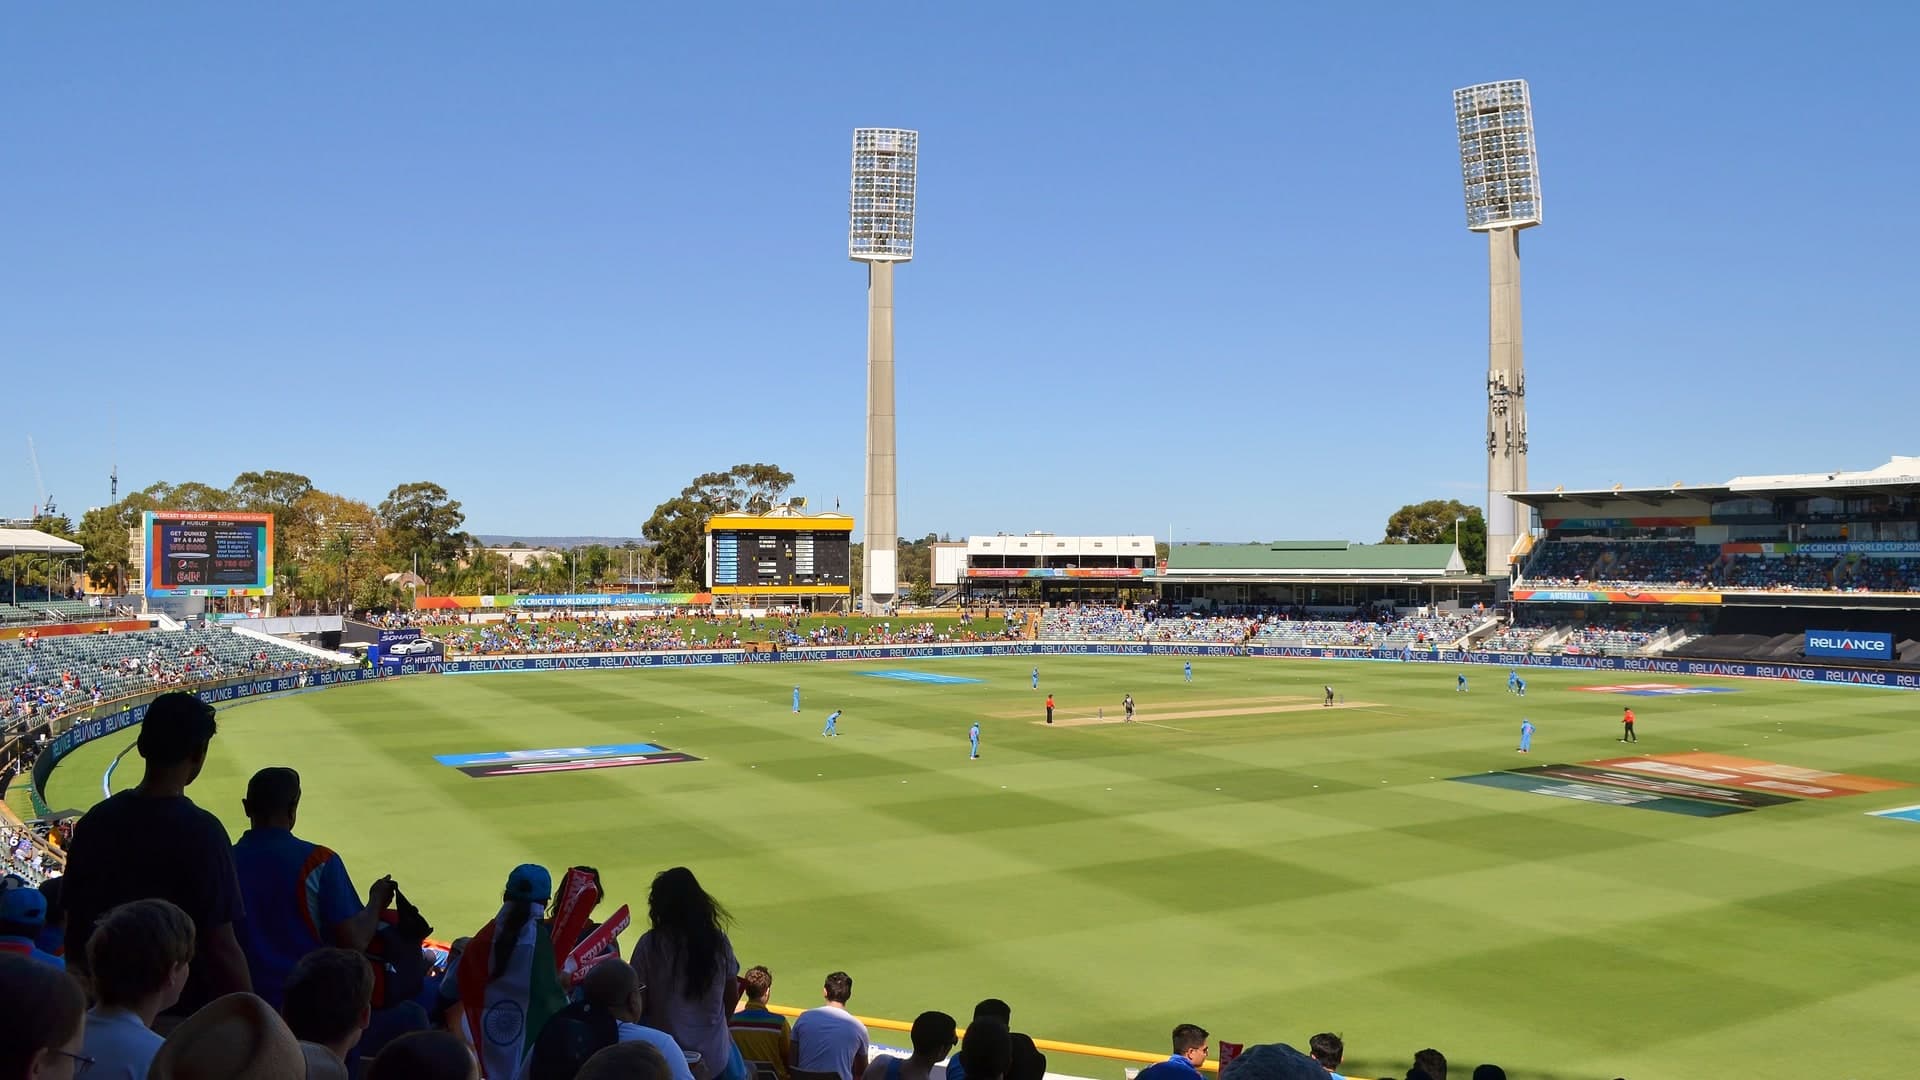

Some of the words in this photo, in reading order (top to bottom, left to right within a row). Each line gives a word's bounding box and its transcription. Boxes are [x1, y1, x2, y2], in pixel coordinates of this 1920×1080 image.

[1796, 543, 1810, 552] ICC
[1811, 543, 1847, 552] CRICKET
[1849, 543, 1884, 552] WORLD
[1884, 543, 1904, 551] CUP
[380, 634, 419, 642] SONATA
[1810, 638, 1885, 650] RELIANCE
[836, 650, 881, 659] RELIANCE
[890, 648, 934, 656] RELIANCE
[942, 646, 984, 656] RELIANCE
[992, 646, 1032, 654] RELIANCE
[1152, 646, 1199, 654] RELIANCE
[1264, 647, 1312, 656] RELIANCE
[414, 656, 442, 664] HYUNDAI
[600, 656, 652, 666] RELIANCE
[662, 654, 712, 664] RELIANCE
[722, 652, 770, 662] RELIANCE
[780, 651, 827, 661] RELIANCE
[1442, 652, 1490, 662] RELIANCE
[1500, 654, 1551, 665] RELIANCE
[470, 660, 524, 670] RELIANCE
[535, 657, 590, 668] RELIANCE
[1562, 656, 1614, 668] RELIANCE
[1624, 659, 1678, 672] RELIANCE
[1688, 663, 1745, 676] RELIANCE
[1756, 666, 1814, 680] RELIANCE
[320, 670, 356, 684] RELIANCE
[1826, 671, 1886, 684] RELIANCE
[238, 681, 272, 696] RELIANCE
[200, 688, 232, 704] RELIANCE
[106, 712, 130, 733] RELIANCE
[74, 722, 102, 743] RELIANCE
